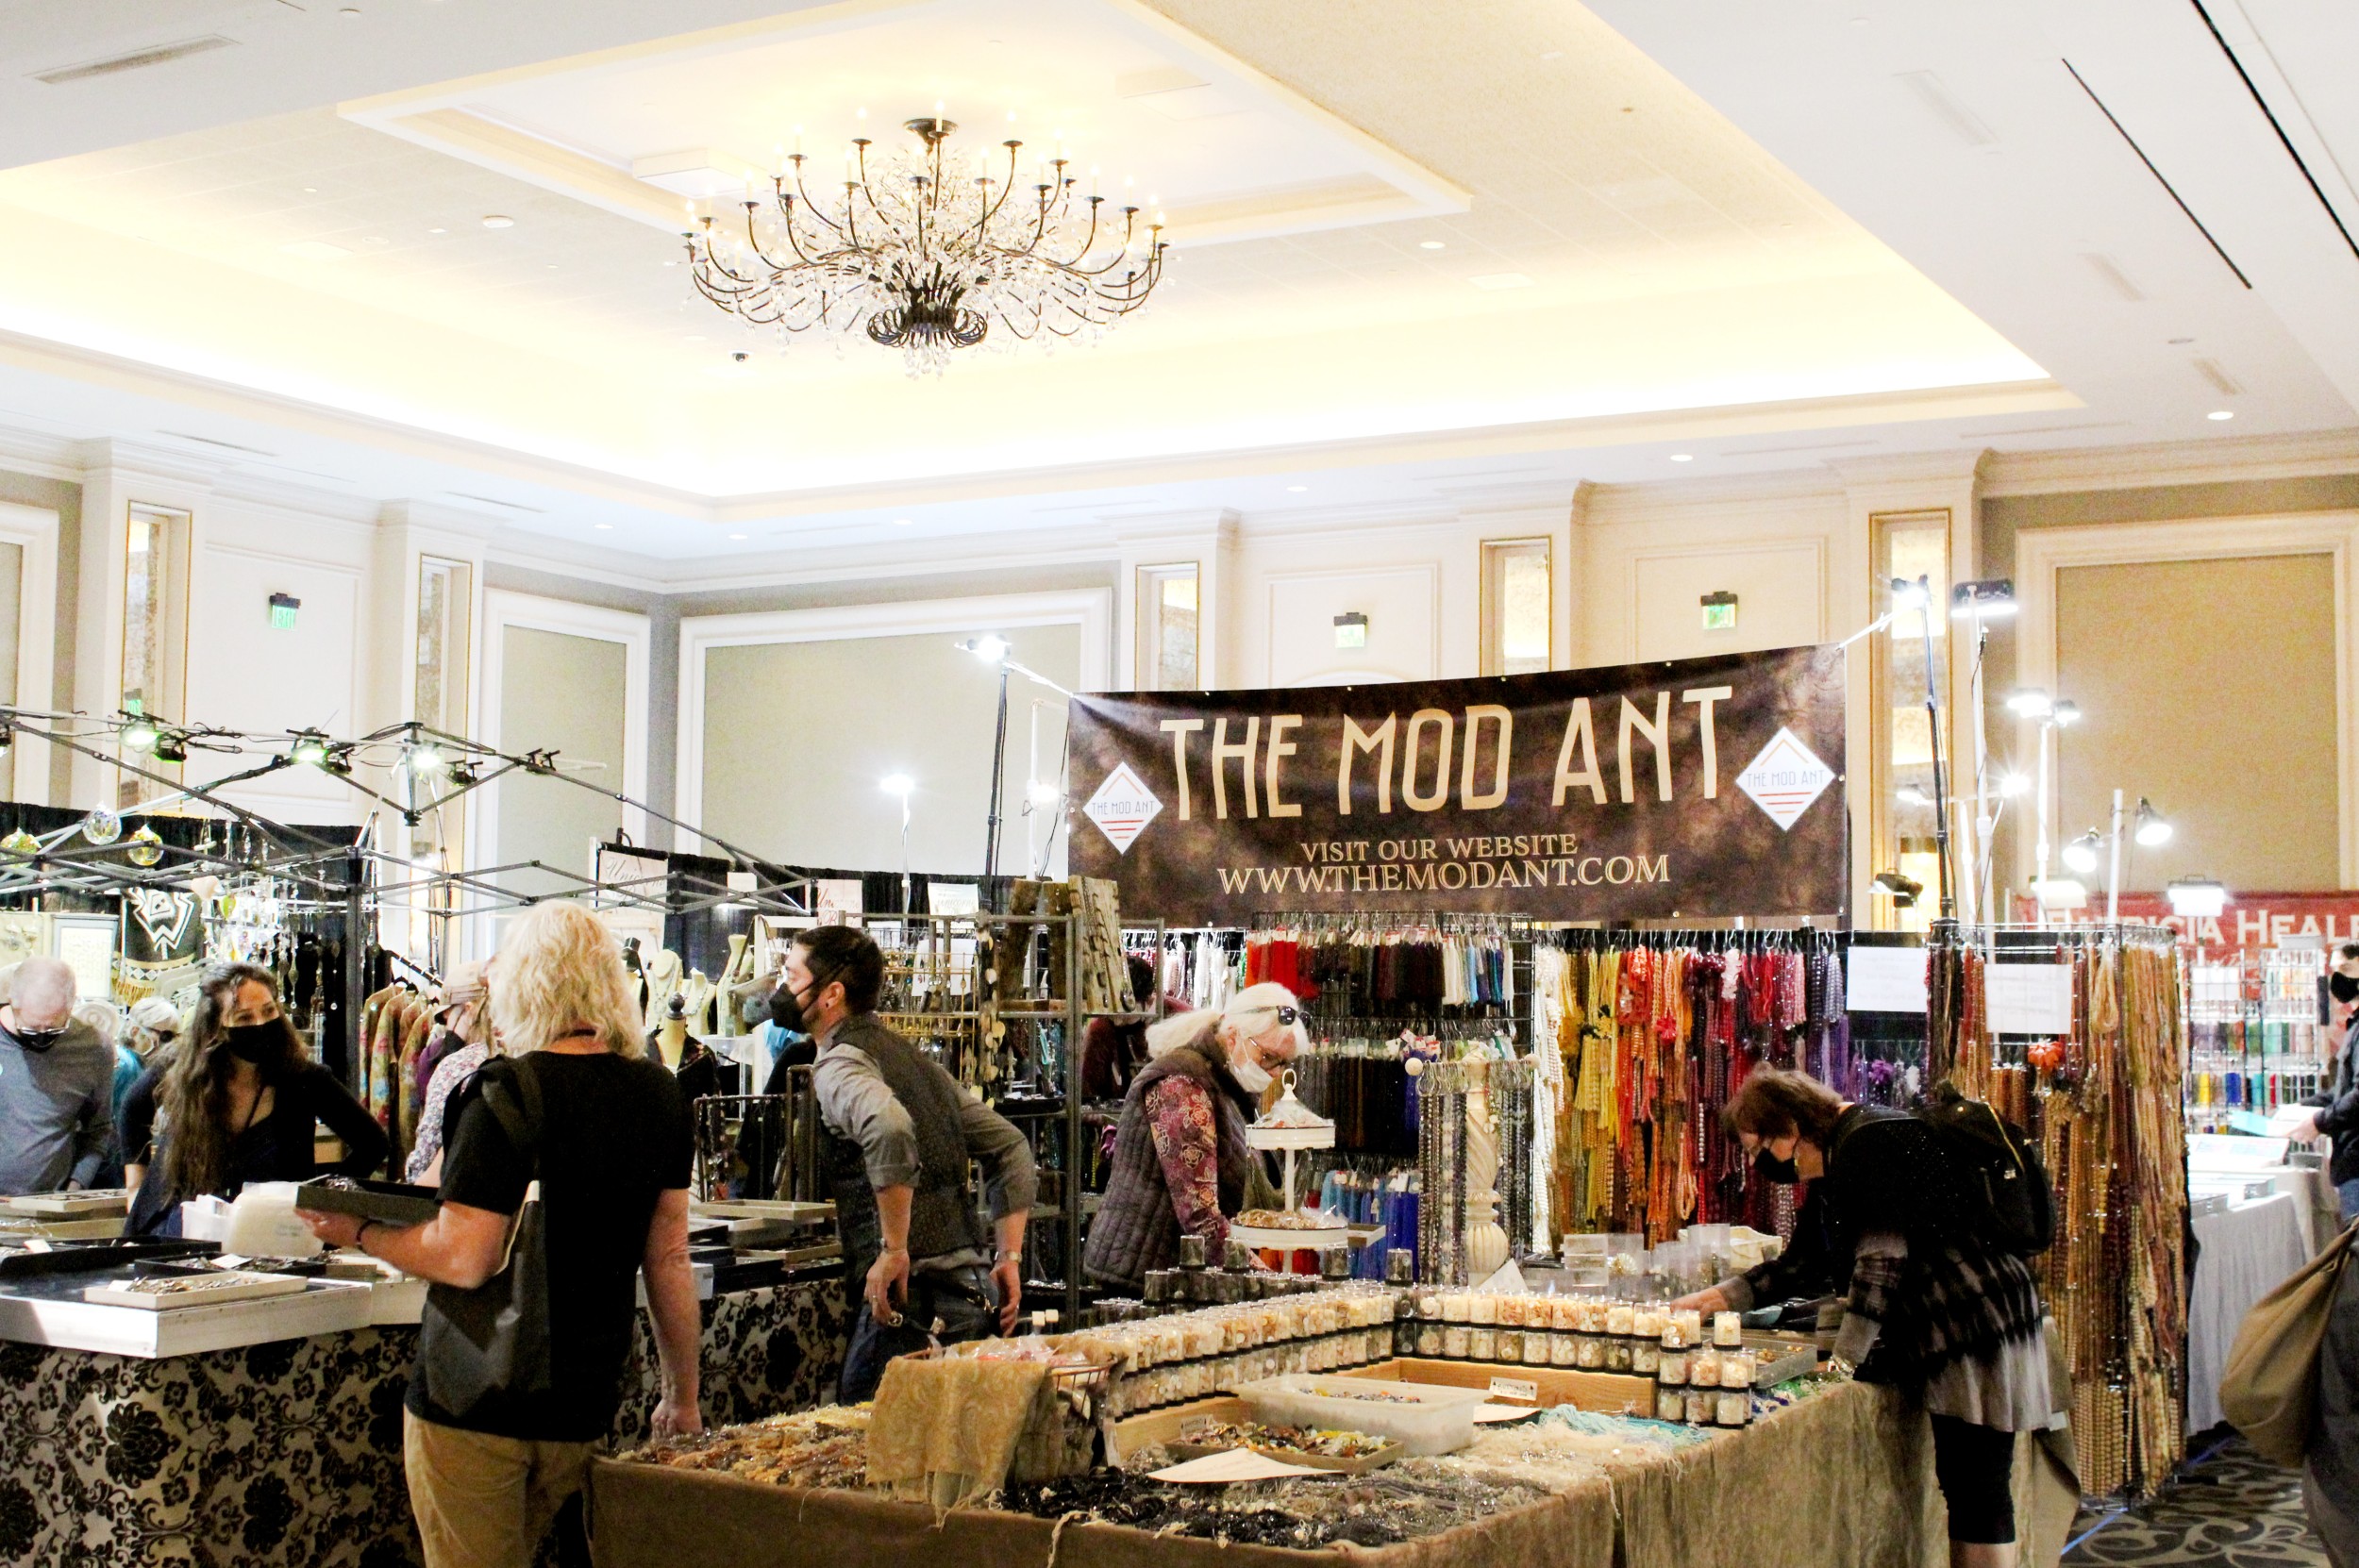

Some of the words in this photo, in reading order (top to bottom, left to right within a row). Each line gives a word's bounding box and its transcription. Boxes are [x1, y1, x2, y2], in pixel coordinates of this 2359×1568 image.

[1159, 714, 1302, 821] THE
[1338, 704, 1513, 815] MOD
[1551, 686, 1732, 807] ANT
[1747, 773, 1767, 787] THE
[1772, 771, 1797, 786] MOD
[1801, 769, 1825, 785] ANT
[1092, 802, 1109, 815] THE
[1112, 801, 1131, 814] MOD
[1135, 800, 1155, 813] ANT
[1300, 841, 1369, 862] VISIT
[1378, 839, 1439, 860] OUR
[1446, 833, 1579, 859] WEBSITE
[1216, 854, 1670, 894] WWW.THEMODANT.COM
